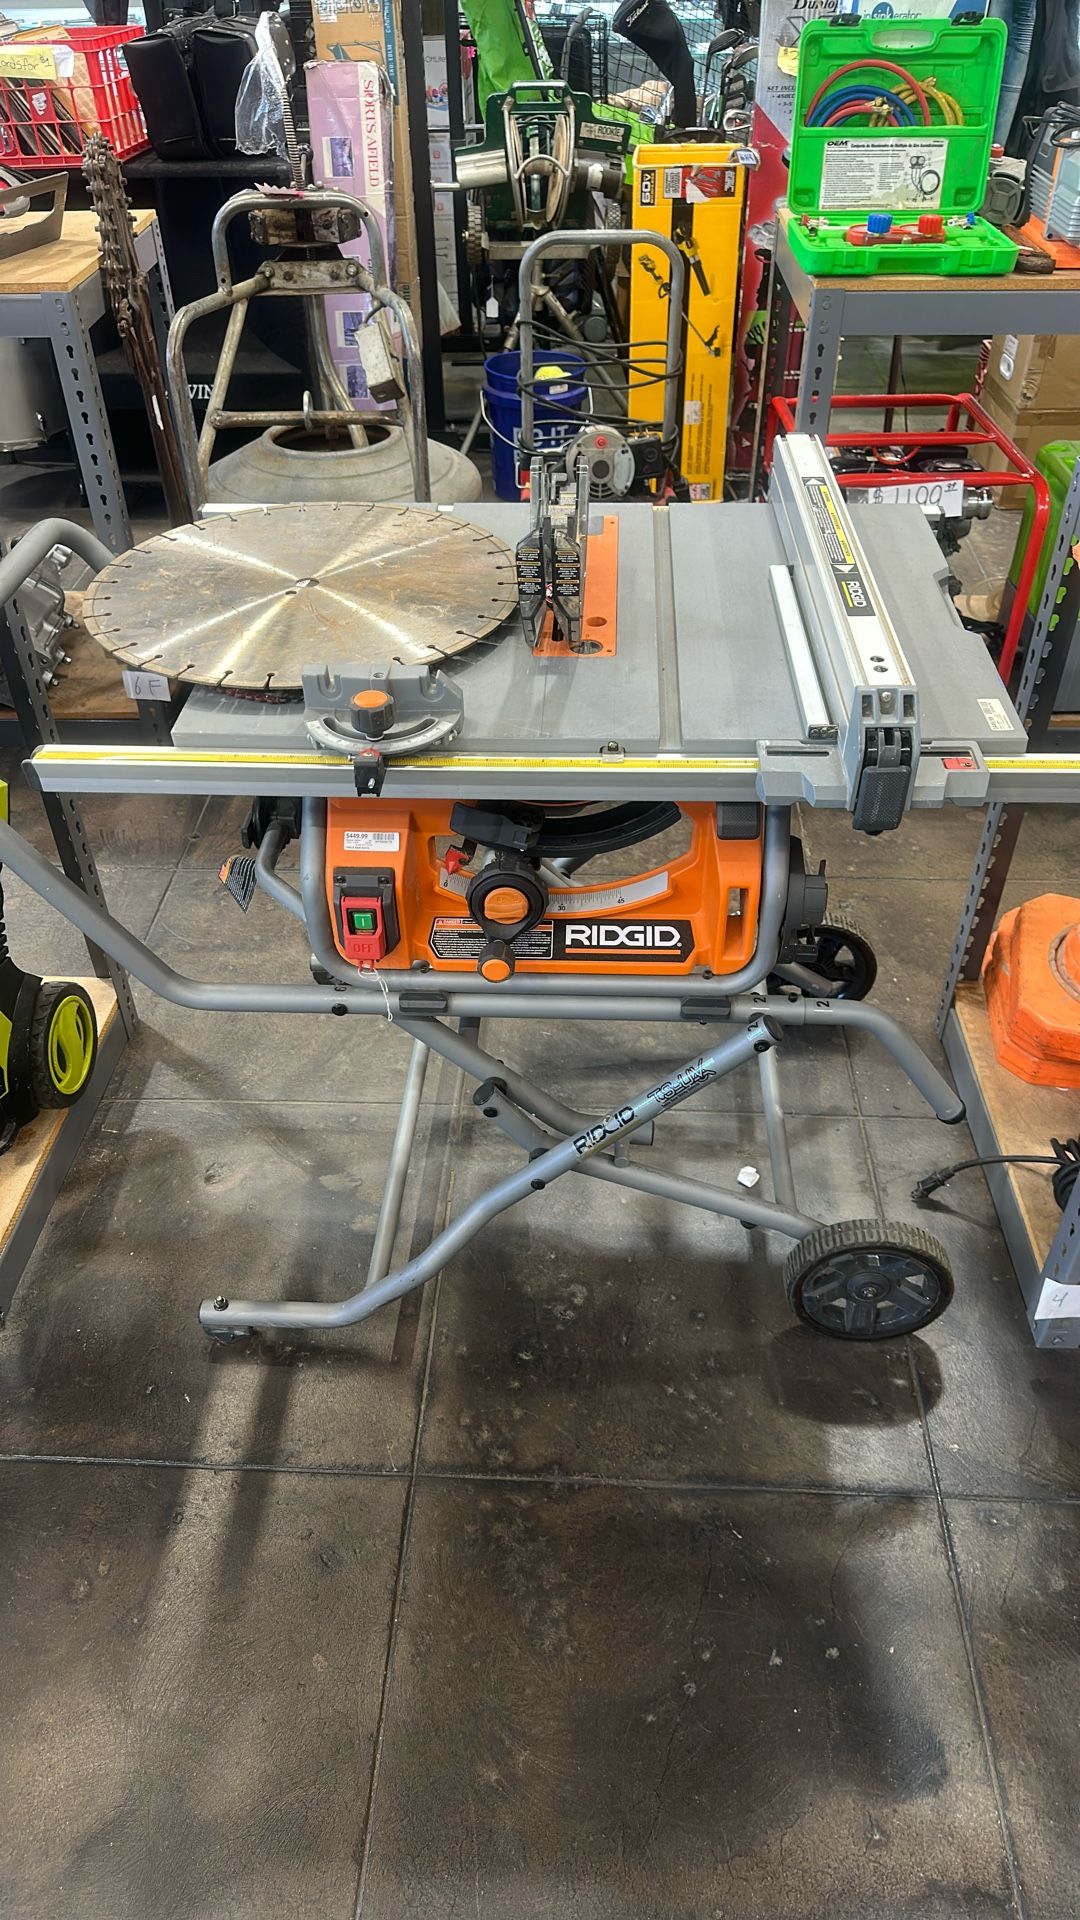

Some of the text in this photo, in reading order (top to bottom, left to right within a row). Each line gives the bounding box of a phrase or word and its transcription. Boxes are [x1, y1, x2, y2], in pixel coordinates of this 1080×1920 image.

[364, 80, 380, 187] SPORTS AFIELD
[846, 580, 867, 608] RIDGID
[566, 924, 681, 946] RIDGID
[354, 944, 374, 952] OFF
[1052, 1292, 1068, 1308] 4
